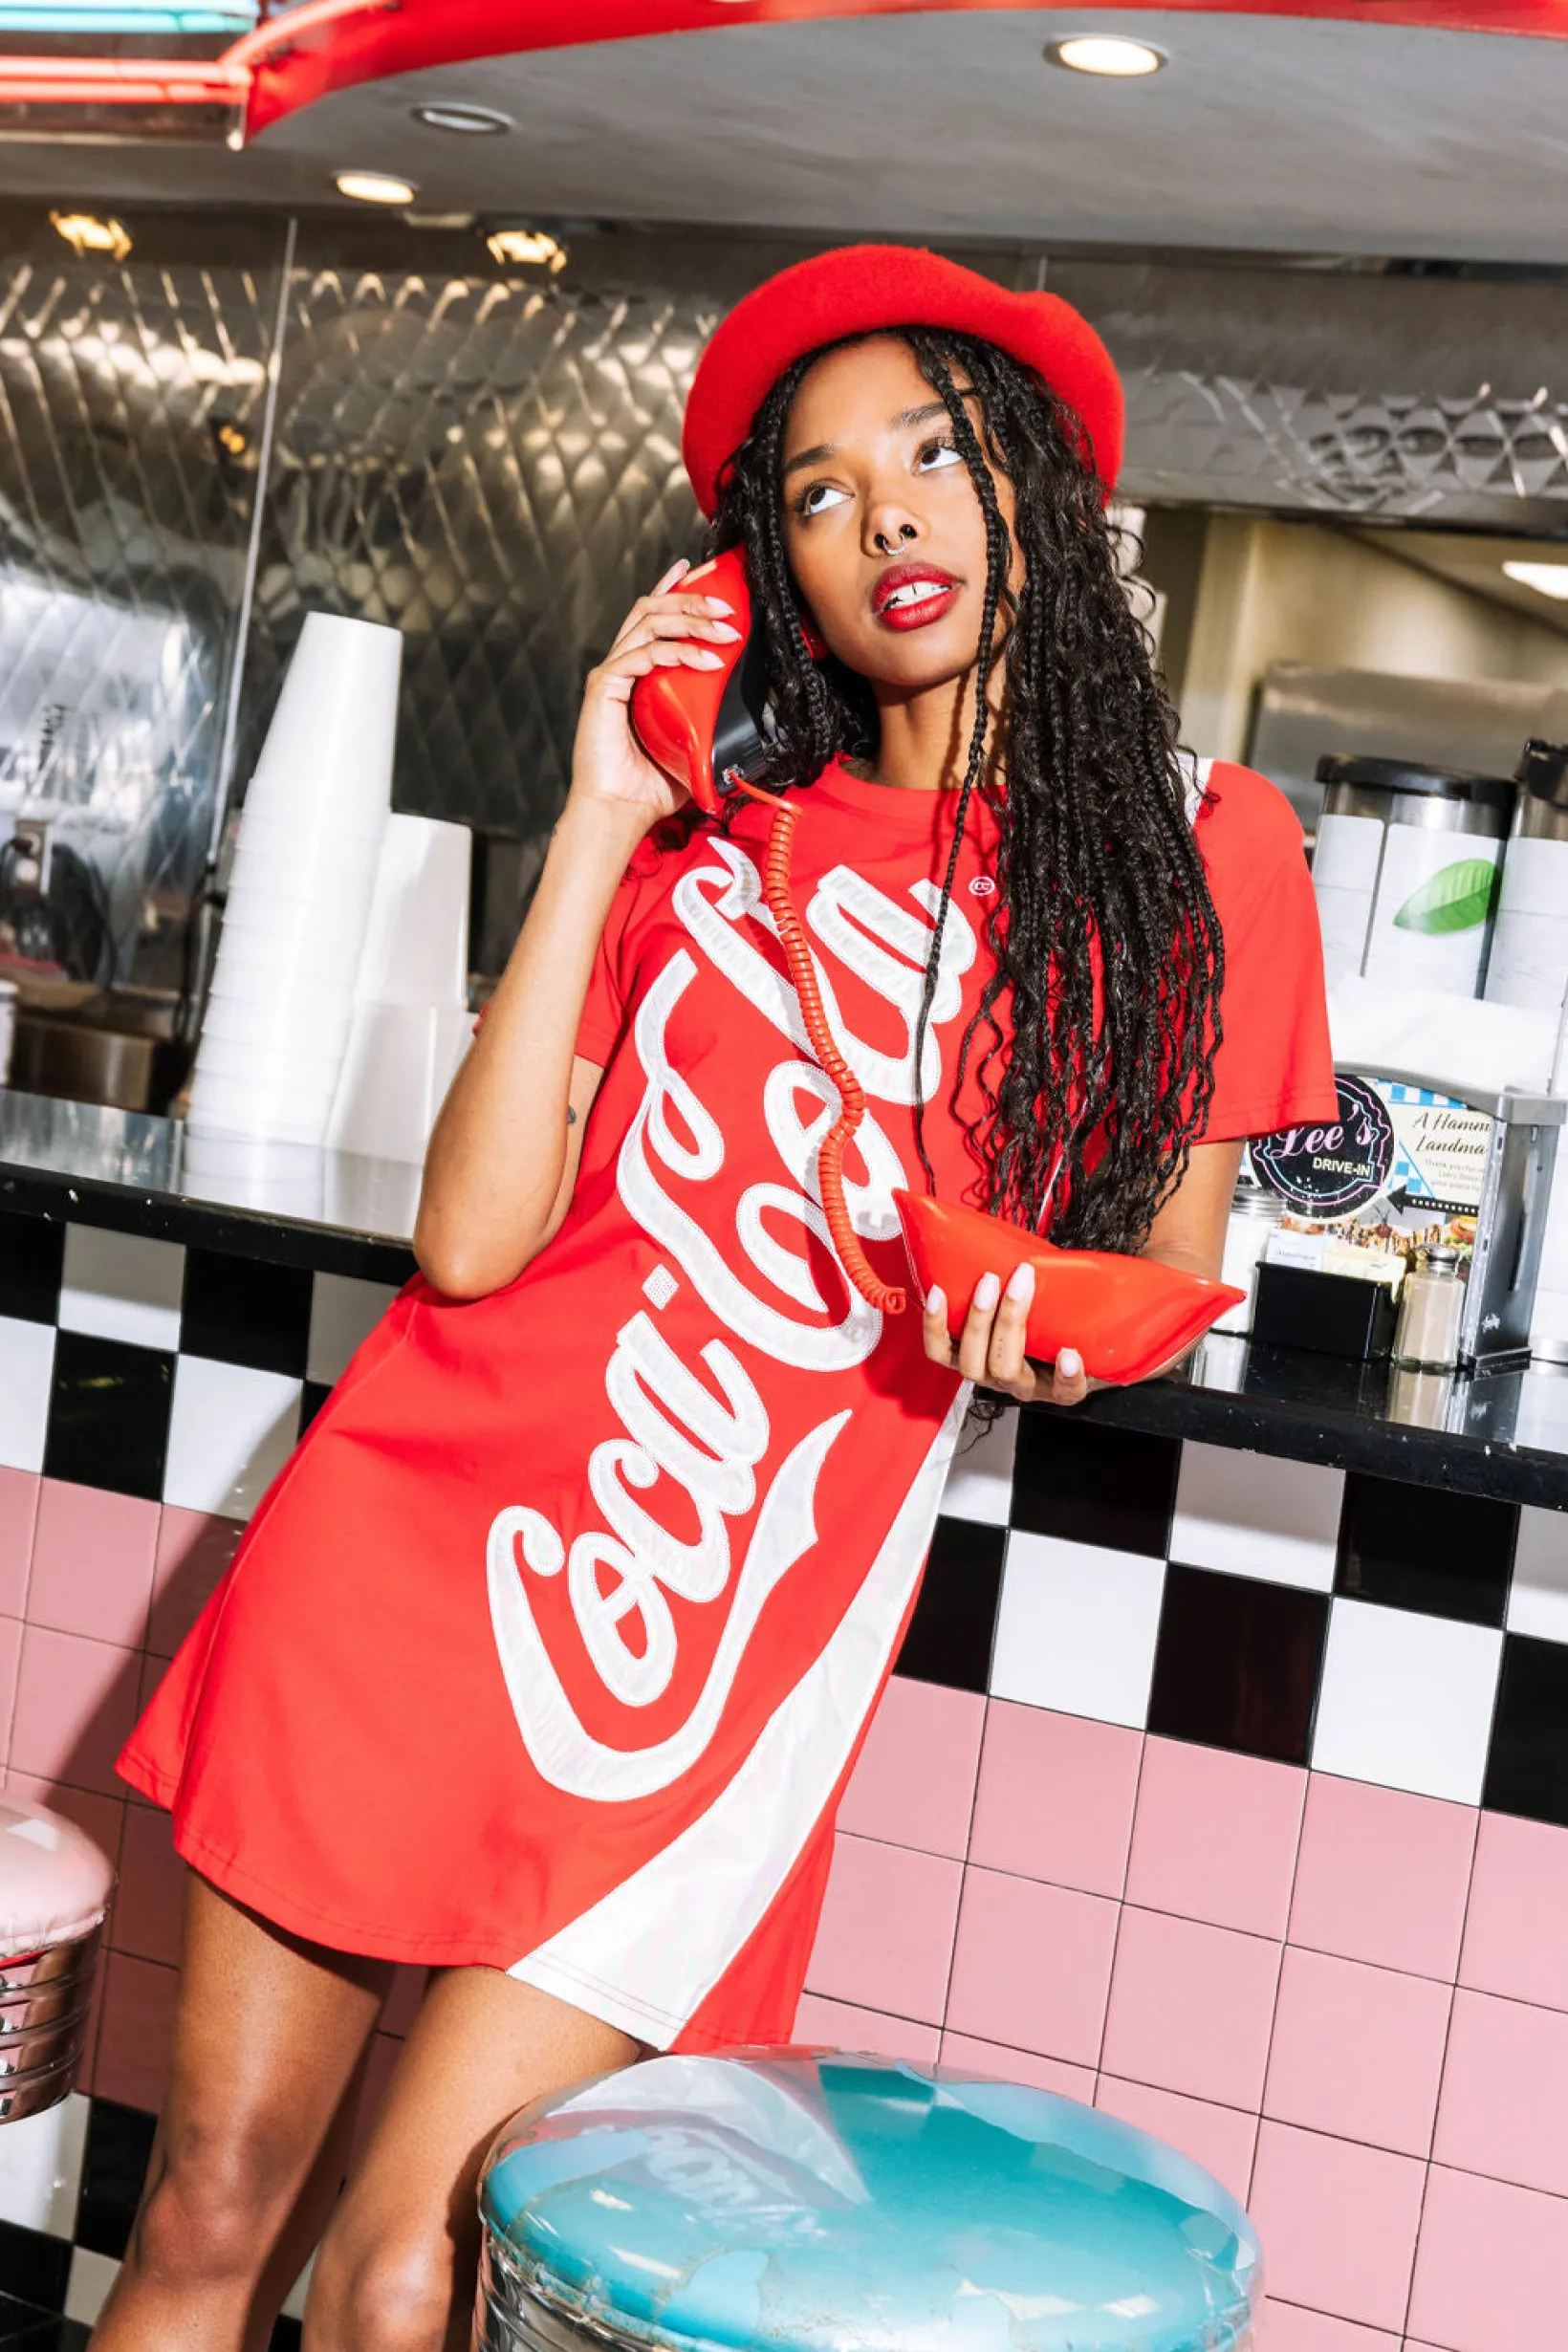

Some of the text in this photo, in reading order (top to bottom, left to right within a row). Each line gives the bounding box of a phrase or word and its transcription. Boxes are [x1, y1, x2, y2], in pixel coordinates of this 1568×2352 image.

[1269, 1102, 1374, 1160] Lee's
[1312, 1157, 1371, 1177] DRIVE-IN
[486, 837, 978, 1802] Coca-Cola
